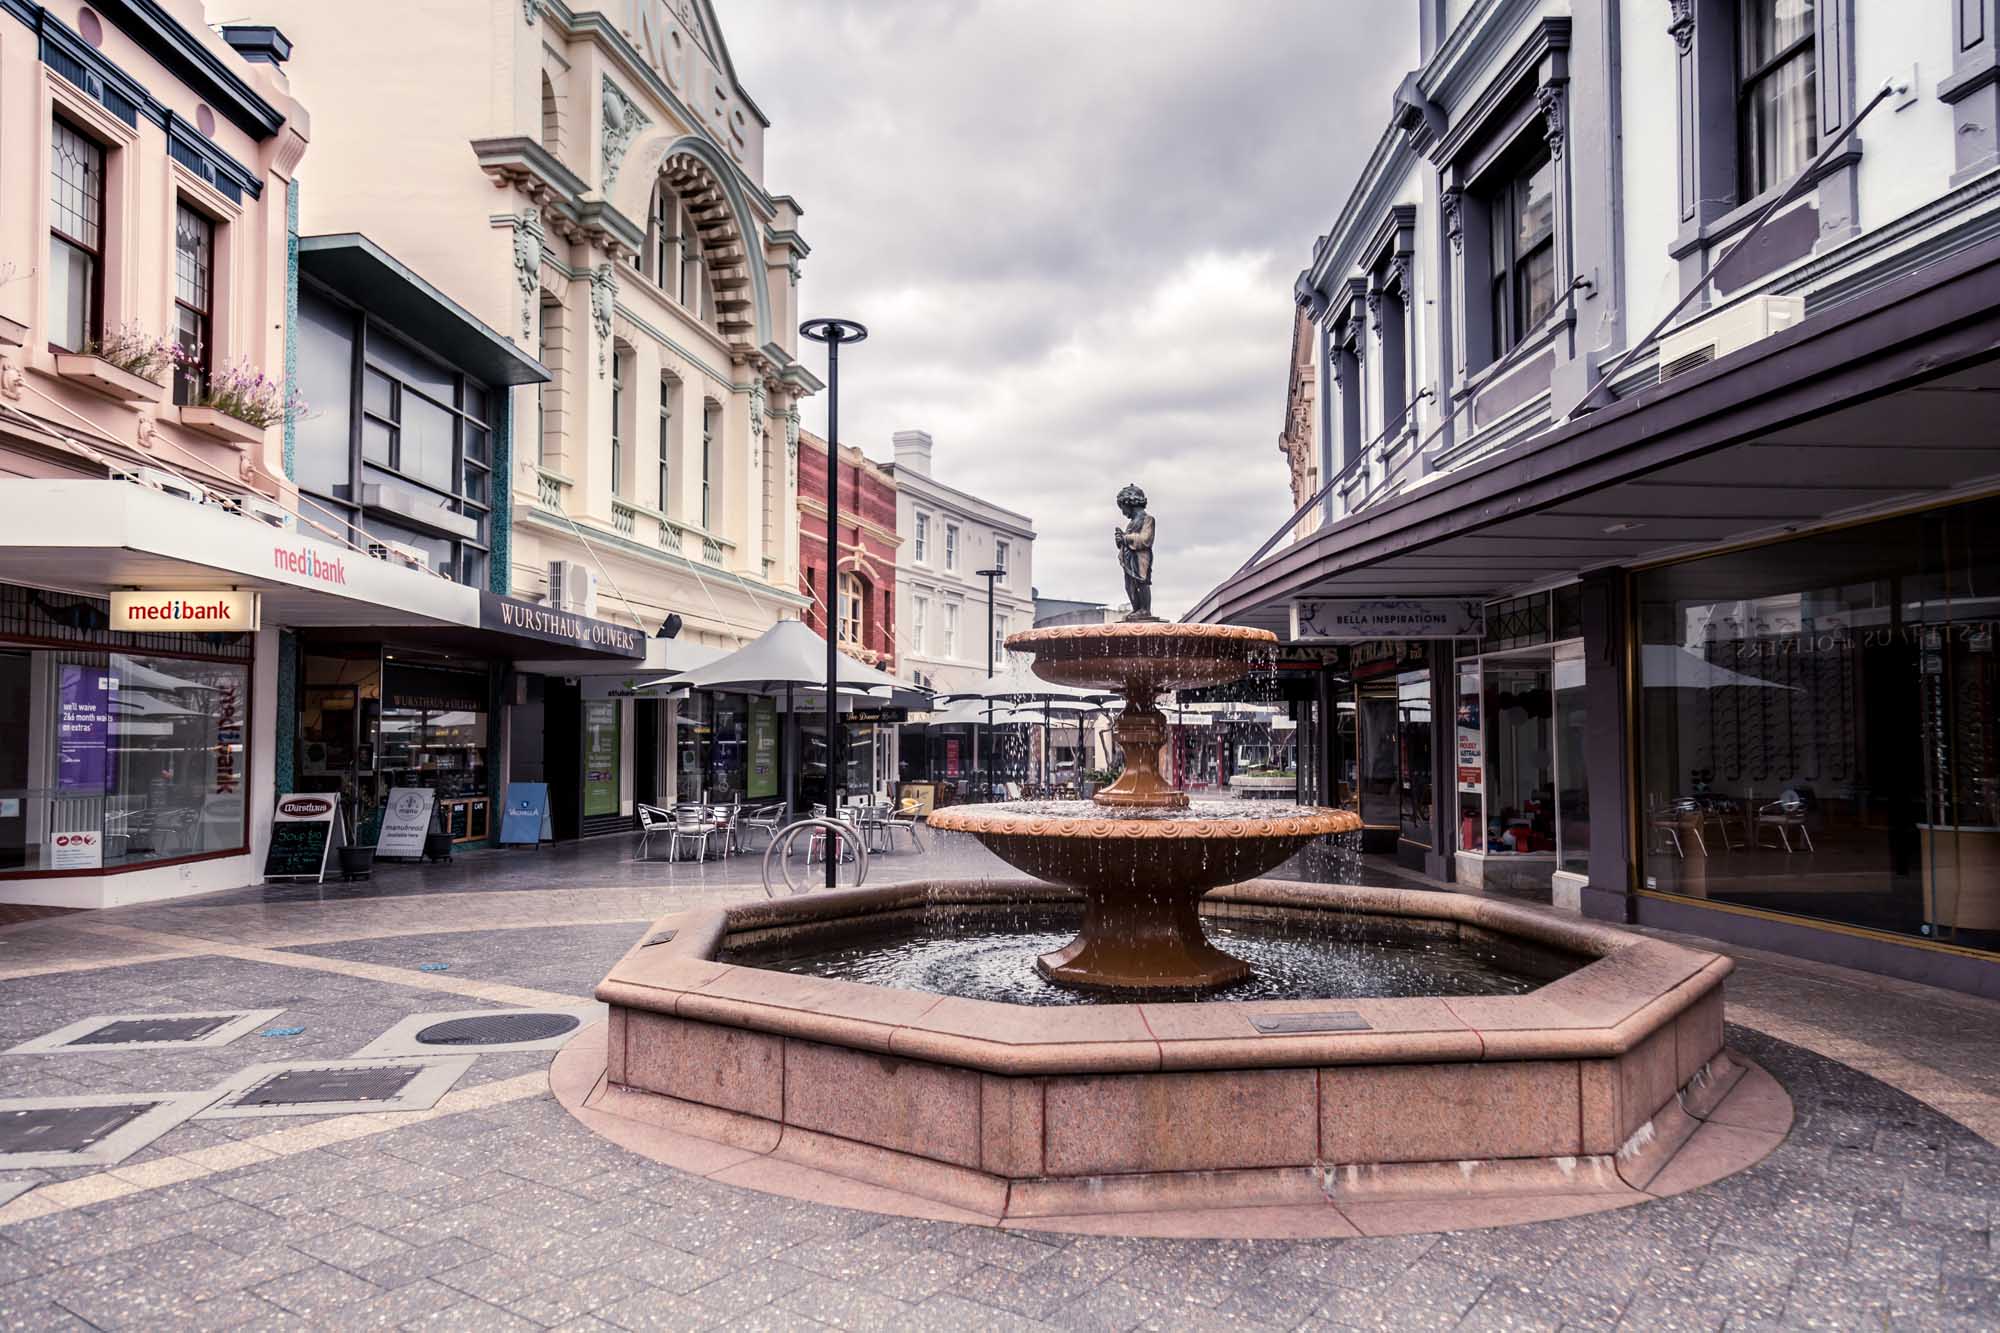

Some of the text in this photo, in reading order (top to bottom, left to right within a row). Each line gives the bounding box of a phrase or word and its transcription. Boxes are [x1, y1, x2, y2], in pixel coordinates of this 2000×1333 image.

[274, 547, 346, 585] medibank
[128, 601, 231, 620] medibank
[1336, 614, 1448, 625] BELLA INSPIRATIONS
[500, 602, 580, 640] WURSTHAUS
[592, 625, 634, 650] OLIVERS
